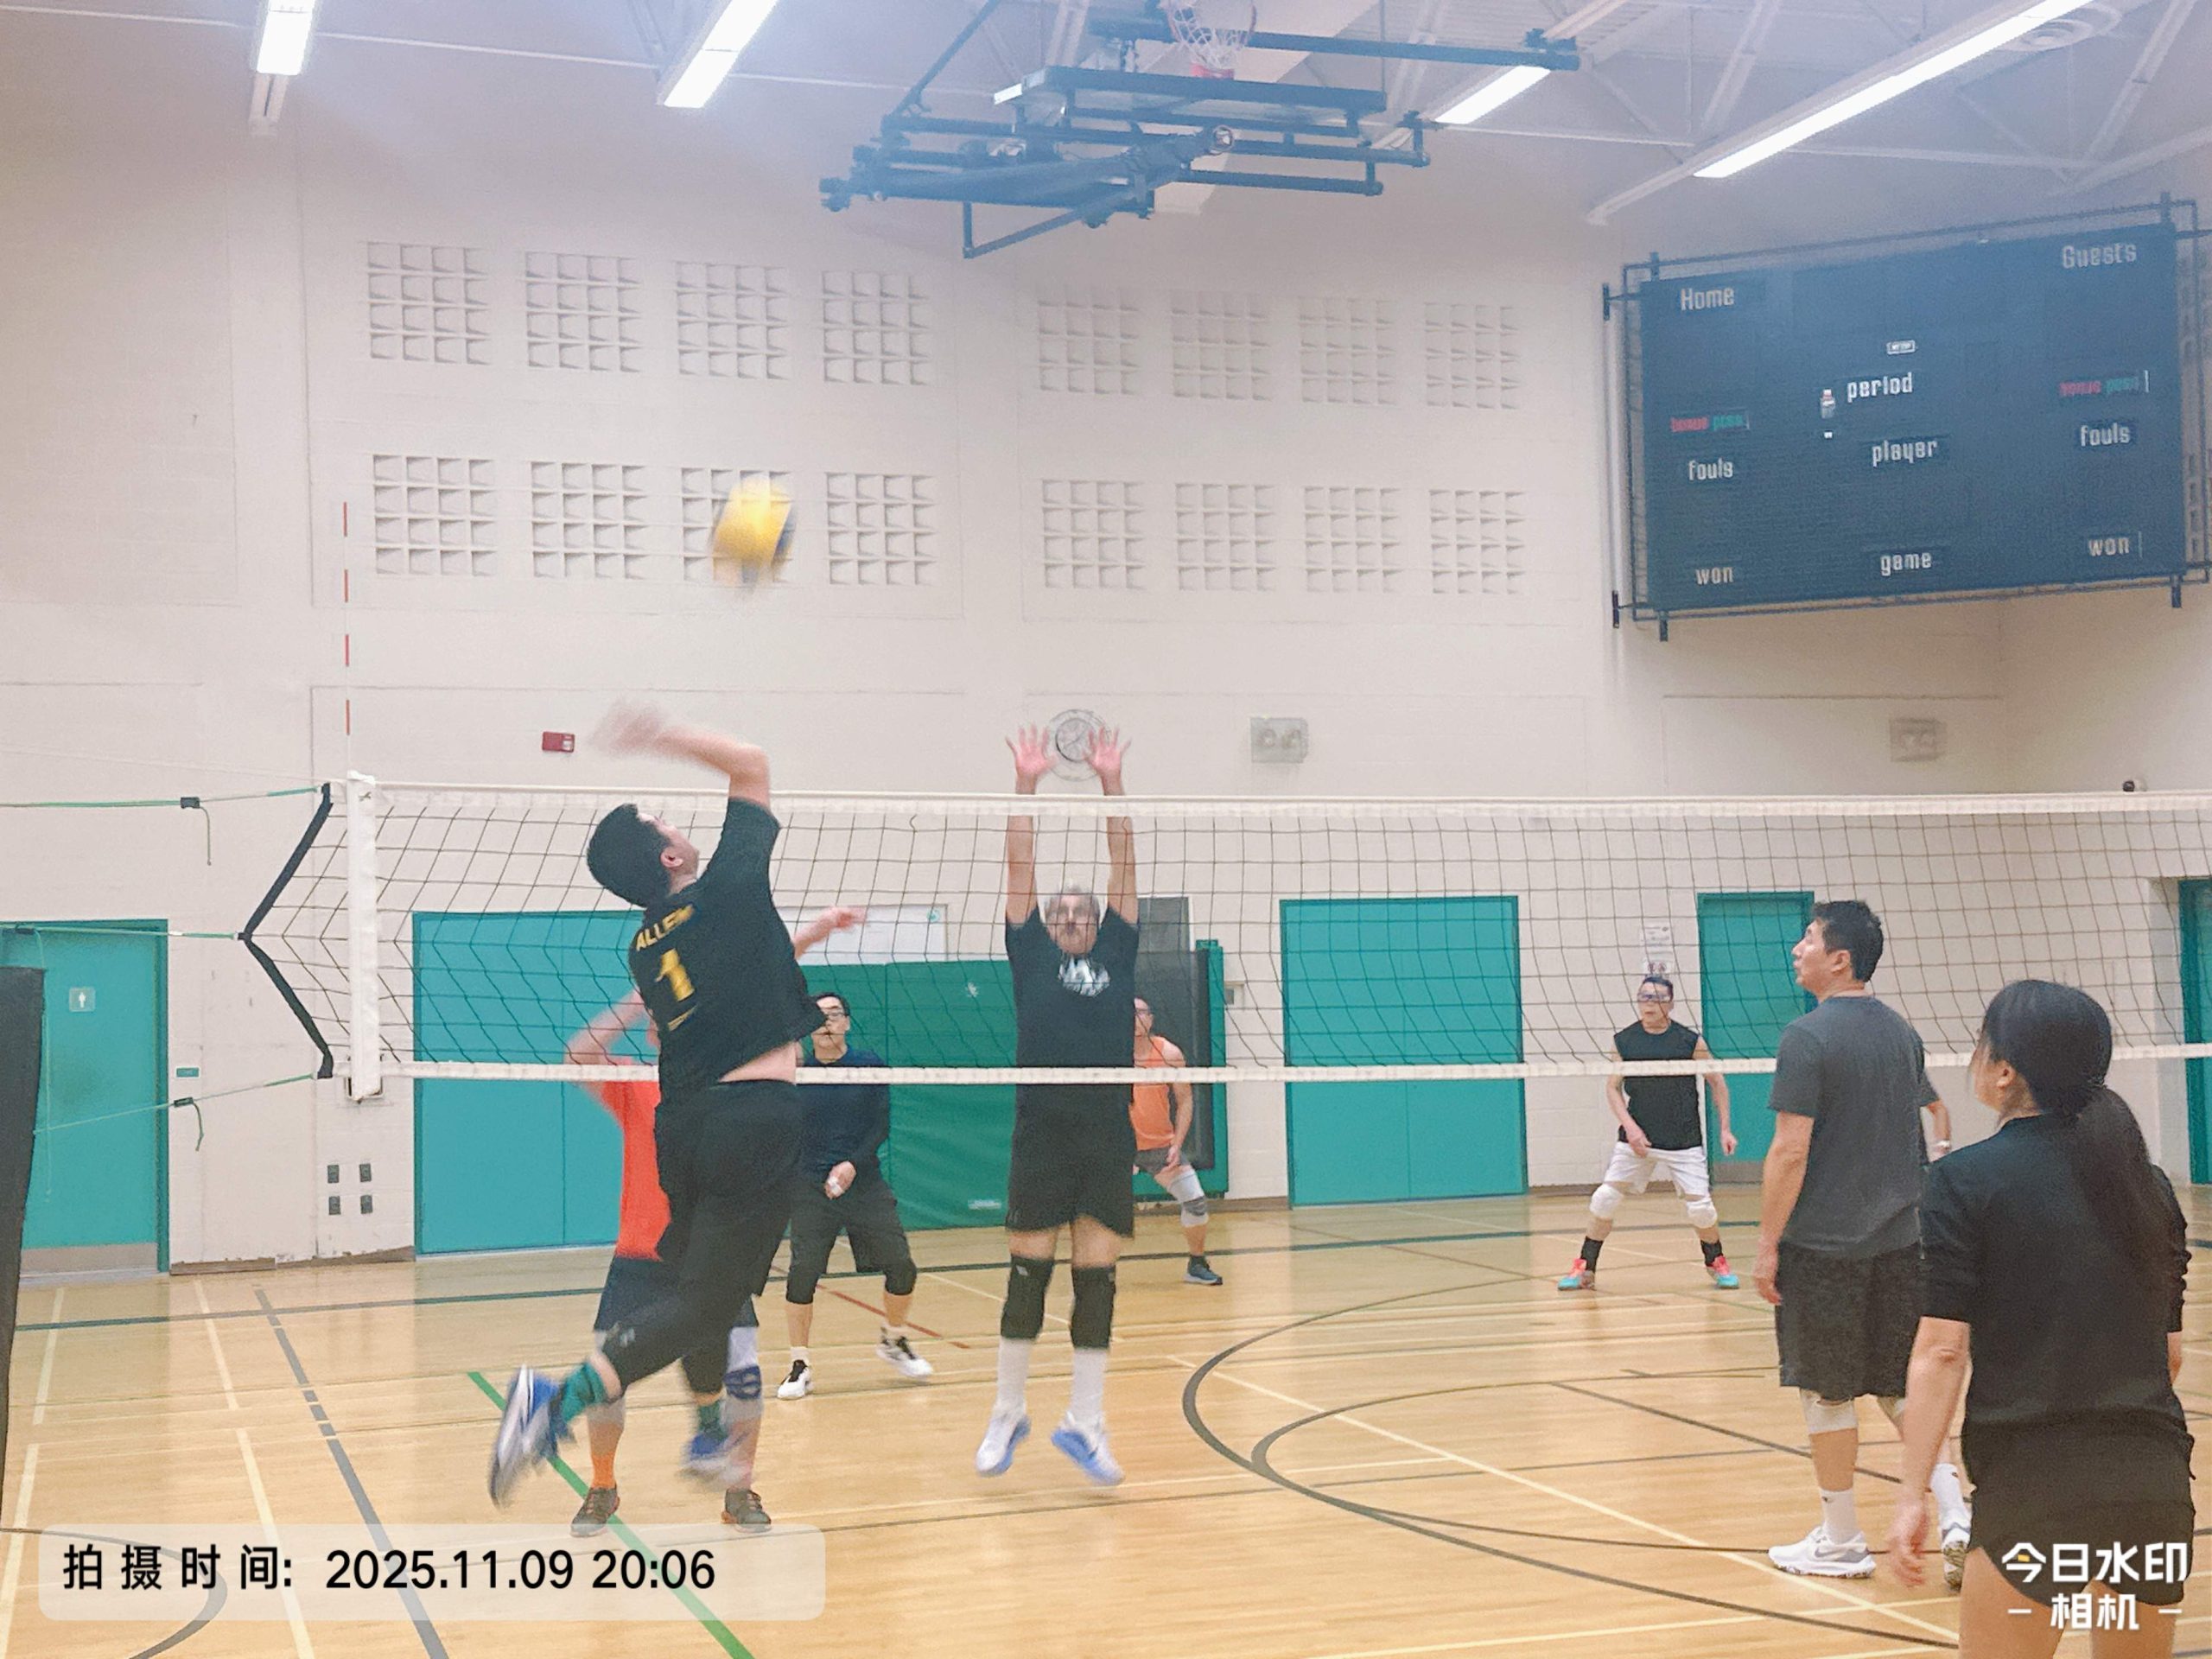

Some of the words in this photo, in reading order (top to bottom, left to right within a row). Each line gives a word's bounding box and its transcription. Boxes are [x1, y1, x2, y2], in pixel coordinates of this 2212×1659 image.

[2062, 243, 2137, 270] Guests
[1681, 287, 1735, 311] Home
[1847, 372, 1913, 403] period
[2080, 423, 2131, 447] fouls
[1872, 440, 1938, 467] player
[1688, 457, 1733, 480] fouls
[2088, 537, 2130, 556] won
[1695, 566, 1734, 585] won
[1880, 552, 1932, 576] game
[655, 948, 695, 1001] 1
